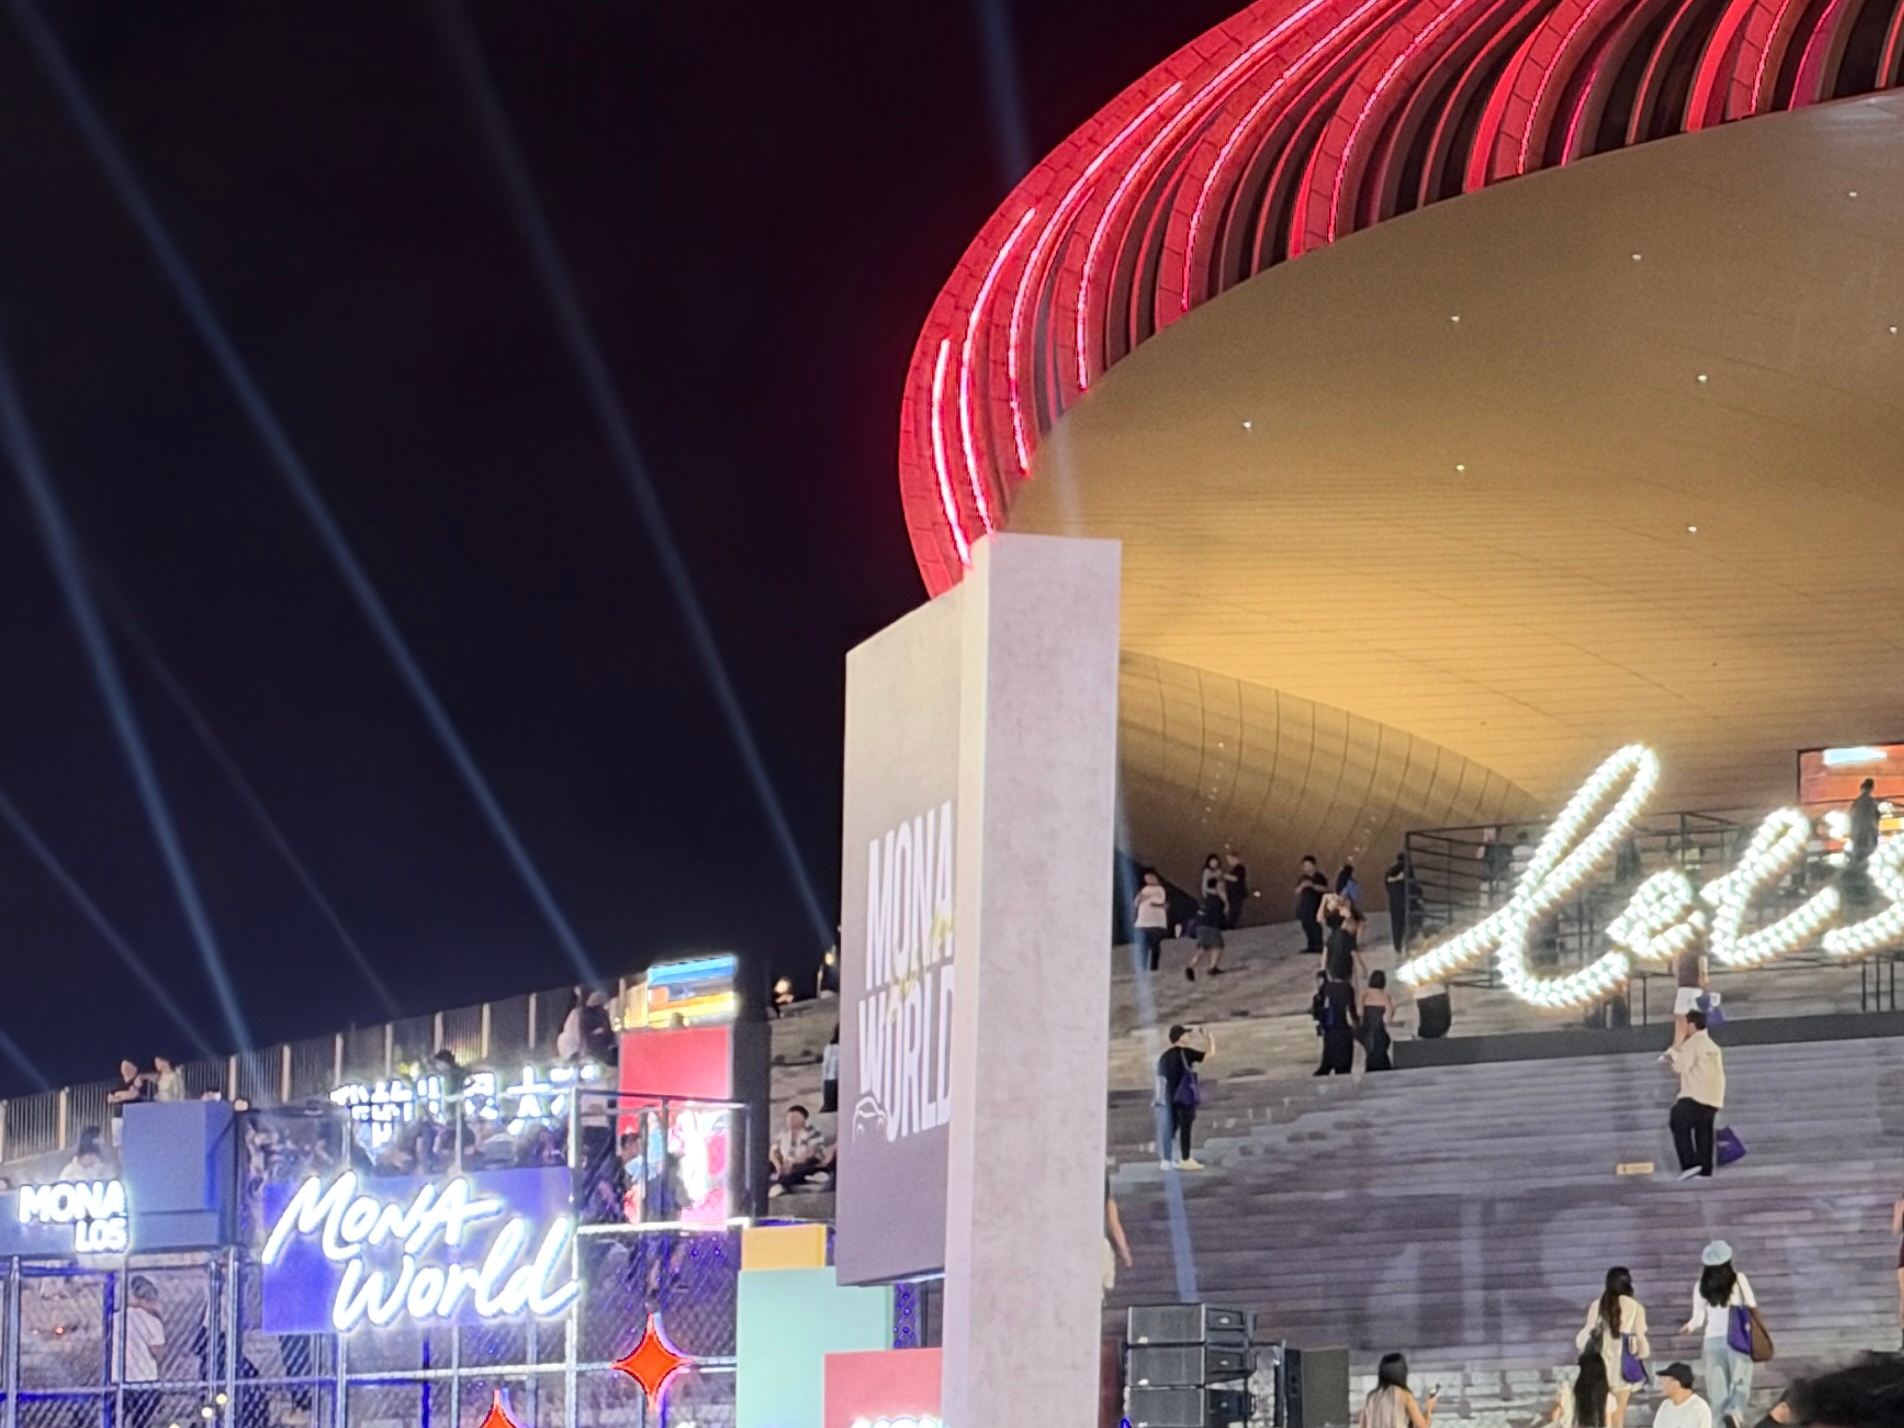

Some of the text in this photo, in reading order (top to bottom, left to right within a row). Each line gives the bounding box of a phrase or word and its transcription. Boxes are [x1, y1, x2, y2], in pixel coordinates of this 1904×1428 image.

[866, 801, 954, 990] MONA
[858, 964, 954, 1143] WORLD
[18, 1180, 128, 1223] MONA
[331, 1216, 582, 1333] World
